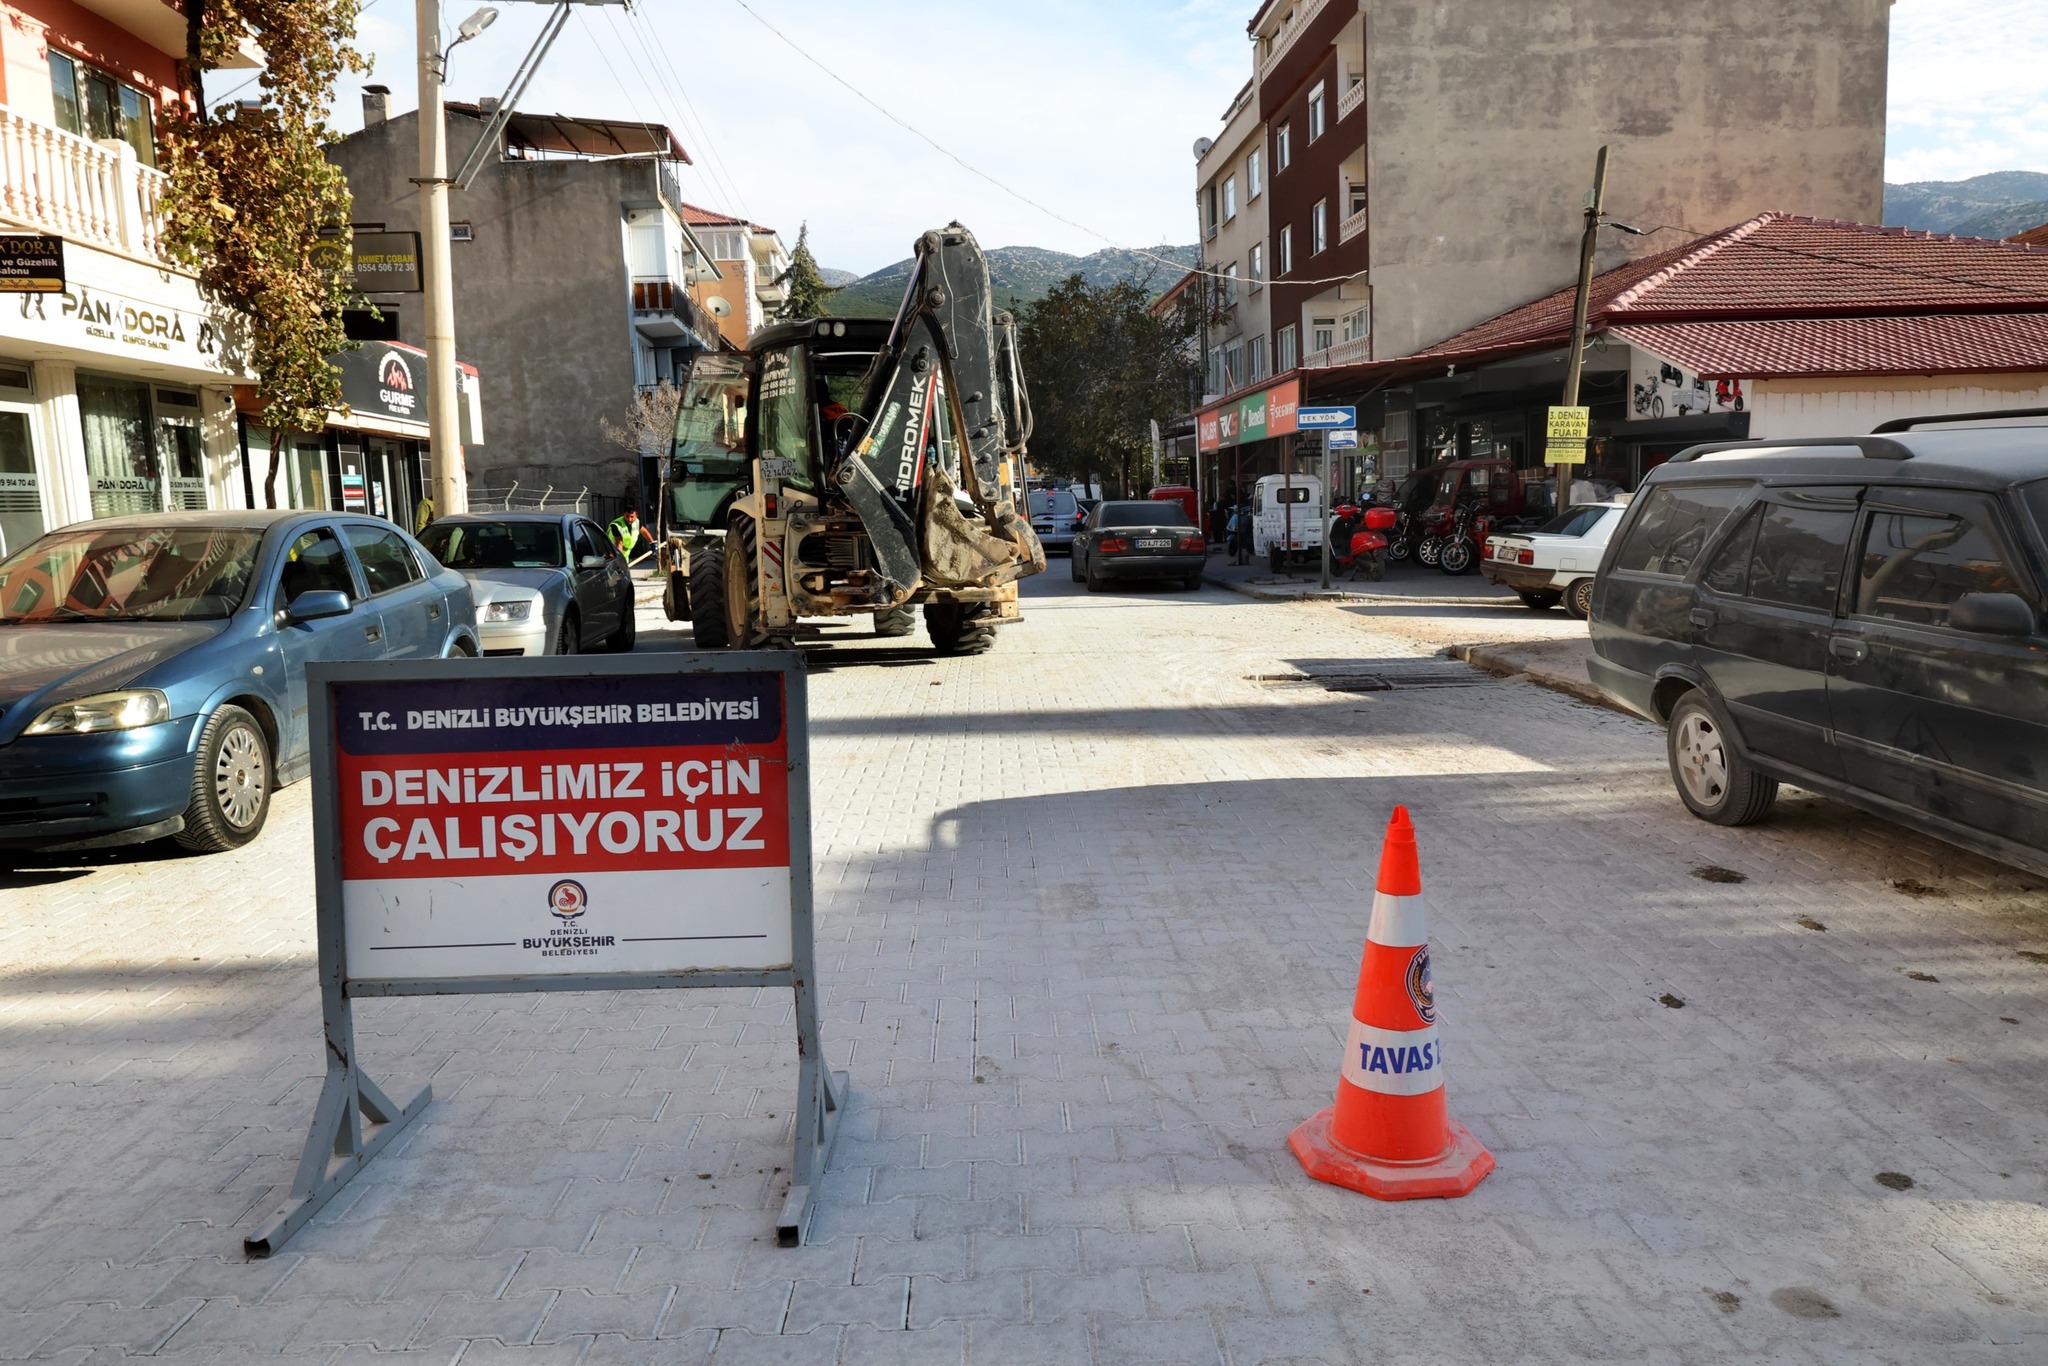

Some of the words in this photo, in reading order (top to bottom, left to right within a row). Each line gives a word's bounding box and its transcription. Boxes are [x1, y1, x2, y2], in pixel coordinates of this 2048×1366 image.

[16, 258, 58, 267] Güzellik
[357, 254, 384, 263] AHMET
[357, 263, 377, 272] 0554
[378, 263, 393, 272] 506
[394, 263, 404, 272] 72
[405, 263, 415, 272] 30
[380, 389, 415, 408] GURME
[1549, 411, 1556, 420] 3.
[1558, 410, 1588, 420] DENİZLİ
[1552, 429, 1582, 437] FUARI
[895, 375, 927, 503] HİDROMEK
[18, 479, 27, 487] 70
[358, 711, 397, 731] T.C.
[406, 708, 491, 730] DENİZLİ
[494, 704, 633, 729] BÜYÜKŞEHİR
[636, 696, 760, 723] BELEDİYESİ
[360, 762, 646, 806] DENİZLİMİZ
[660, 759, 761, 805] İÇİN
[362, 807, 766, 864] ÇALIŞIYORUZ
[550, 928, 588, 936] DENİZLİ
[522, 935, 616, 950] BÜYÜKŞEHİR
[541, 949, 598, 957] BELEDİYESİ
[1360, 1042, 1433, 1075] TAVAS
